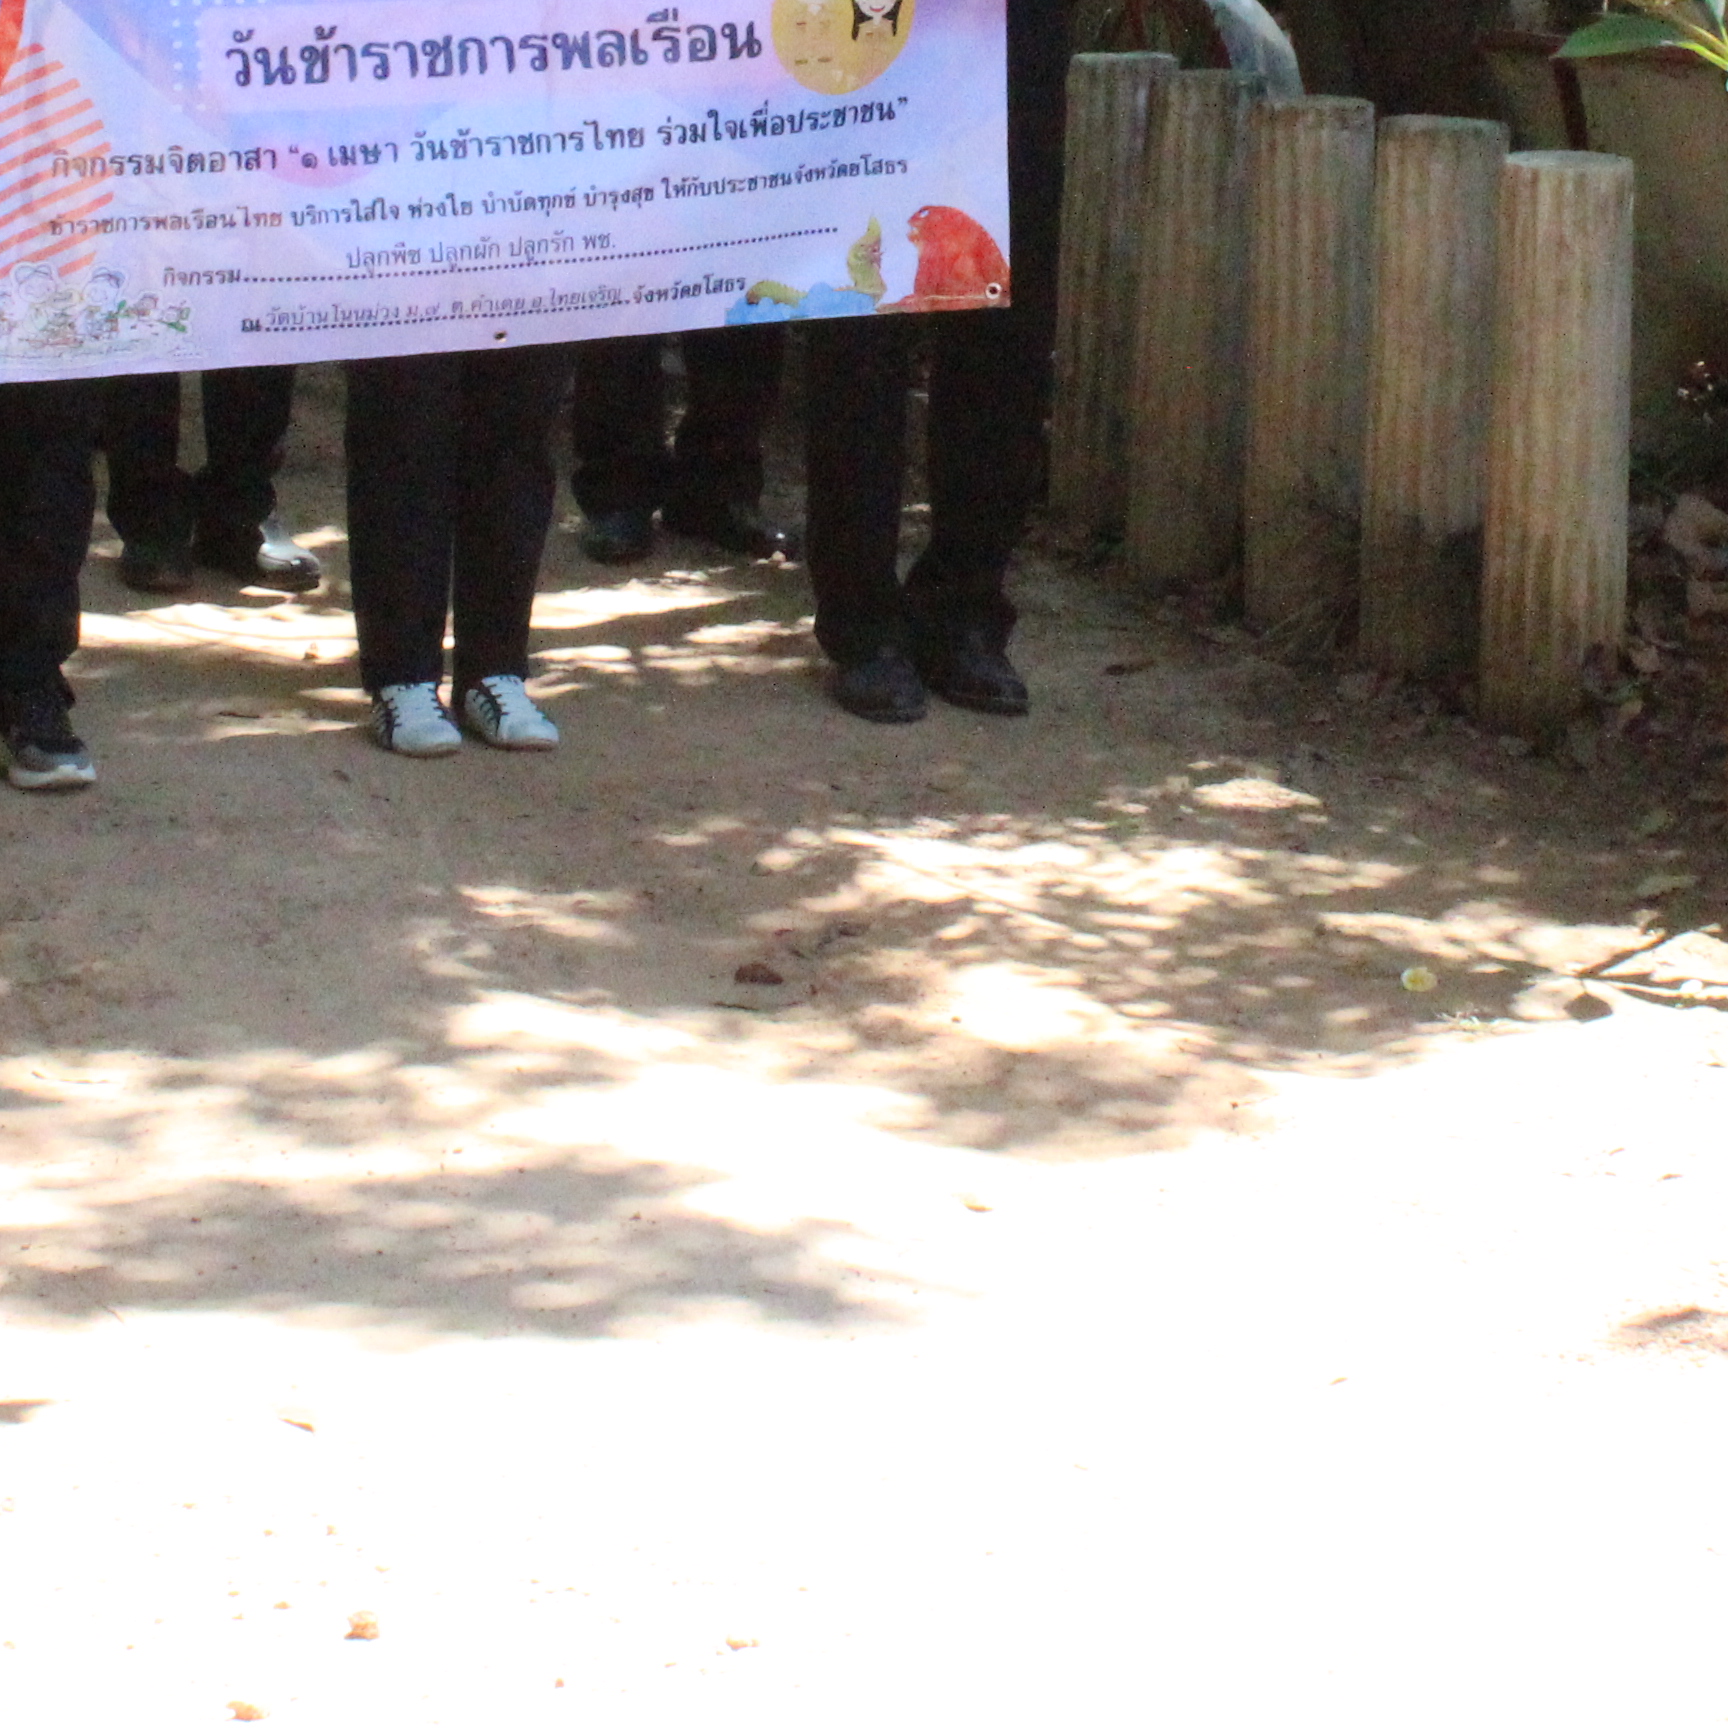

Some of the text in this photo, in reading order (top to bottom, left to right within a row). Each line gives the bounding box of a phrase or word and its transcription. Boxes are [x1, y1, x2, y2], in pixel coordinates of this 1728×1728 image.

[225, 8, 762, 87] วันข้าราชการพลเรือน
[51, 144, 279, 178] กิจกรรมจิตอาสา
[328, 139, 399, 168] เมษา
[411, 120, 645, 162] วันข้าราชการไทย
[291, 197, 400, 227] บริการใส่ใจ
[408, 192, 473, 219] ห่วงใย
[481, 187, 576, 217] บำบัดทุกข์
[584, 185, 655, 211] บำรุงสุข
[346, 241, 422, 275] ปลูกพืช
[429, 236, 501, 271] ปลูกผัก
[509, 230, 574, 264] ปลูกรัก
[583, 232, 616, 250] พช.
